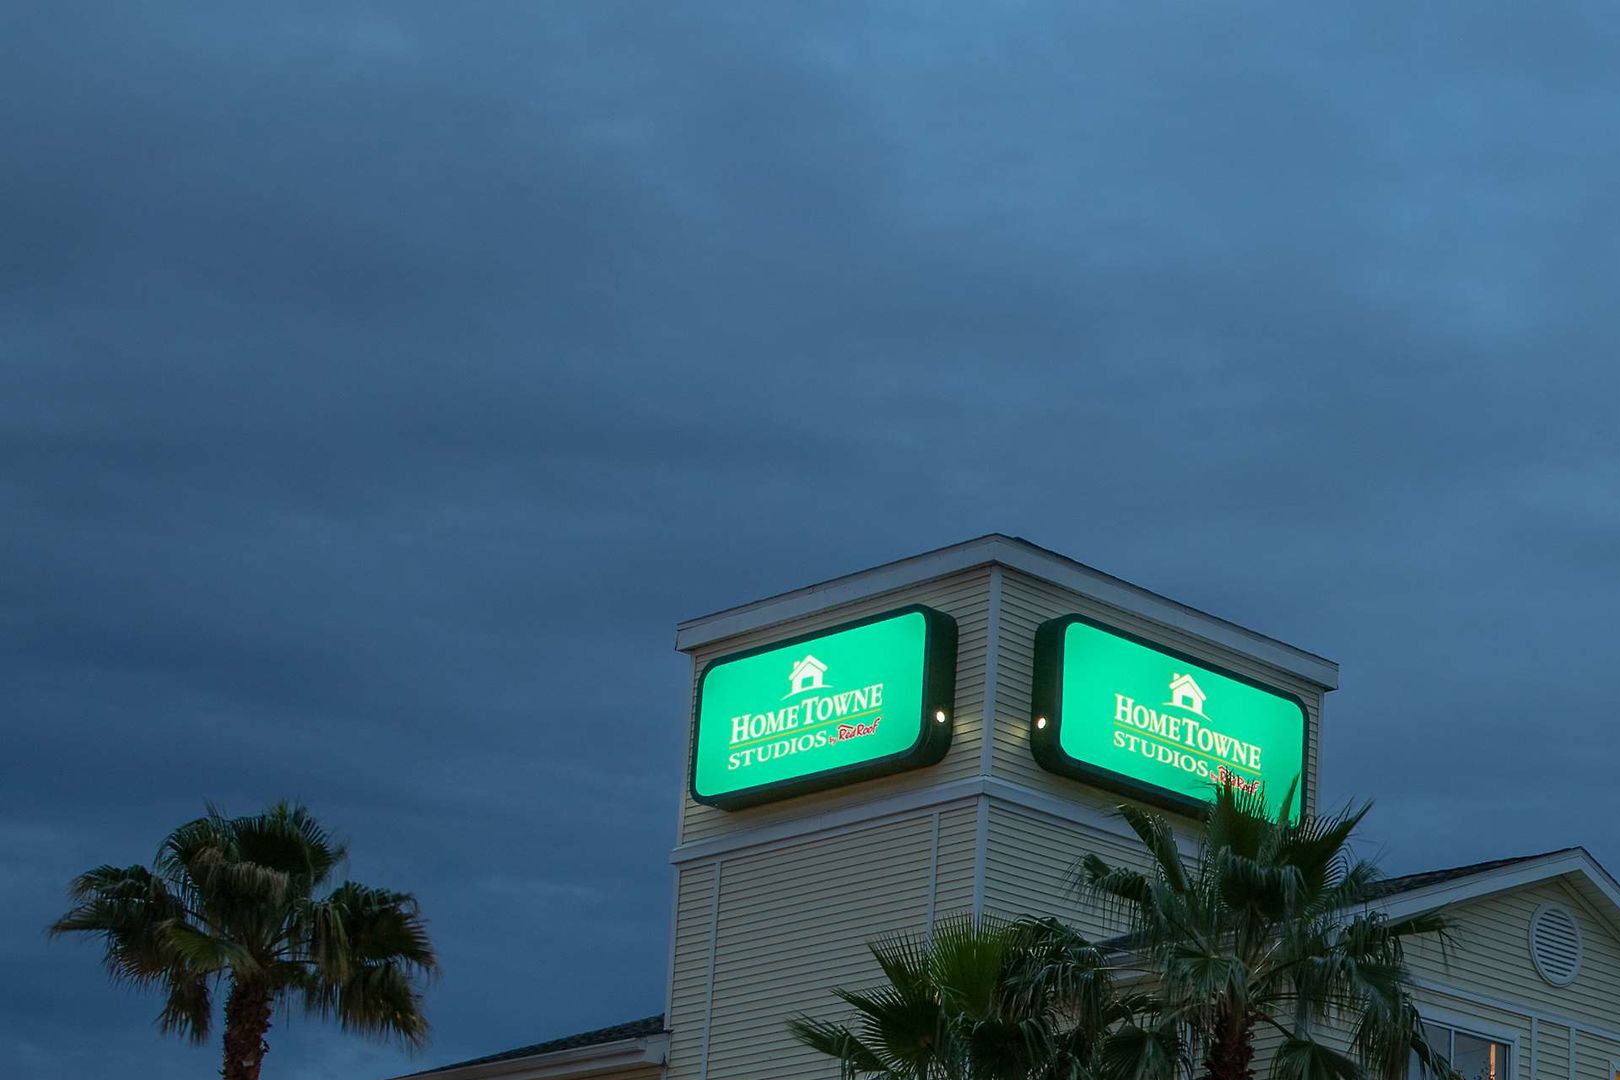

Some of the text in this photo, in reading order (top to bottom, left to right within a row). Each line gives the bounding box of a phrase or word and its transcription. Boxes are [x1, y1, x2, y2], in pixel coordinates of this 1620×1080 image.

[728, 730, 828, 770] STUDIOS
[828, 735, 837, 746] by
[1113, 731, 1209, 777] STUDIOS
